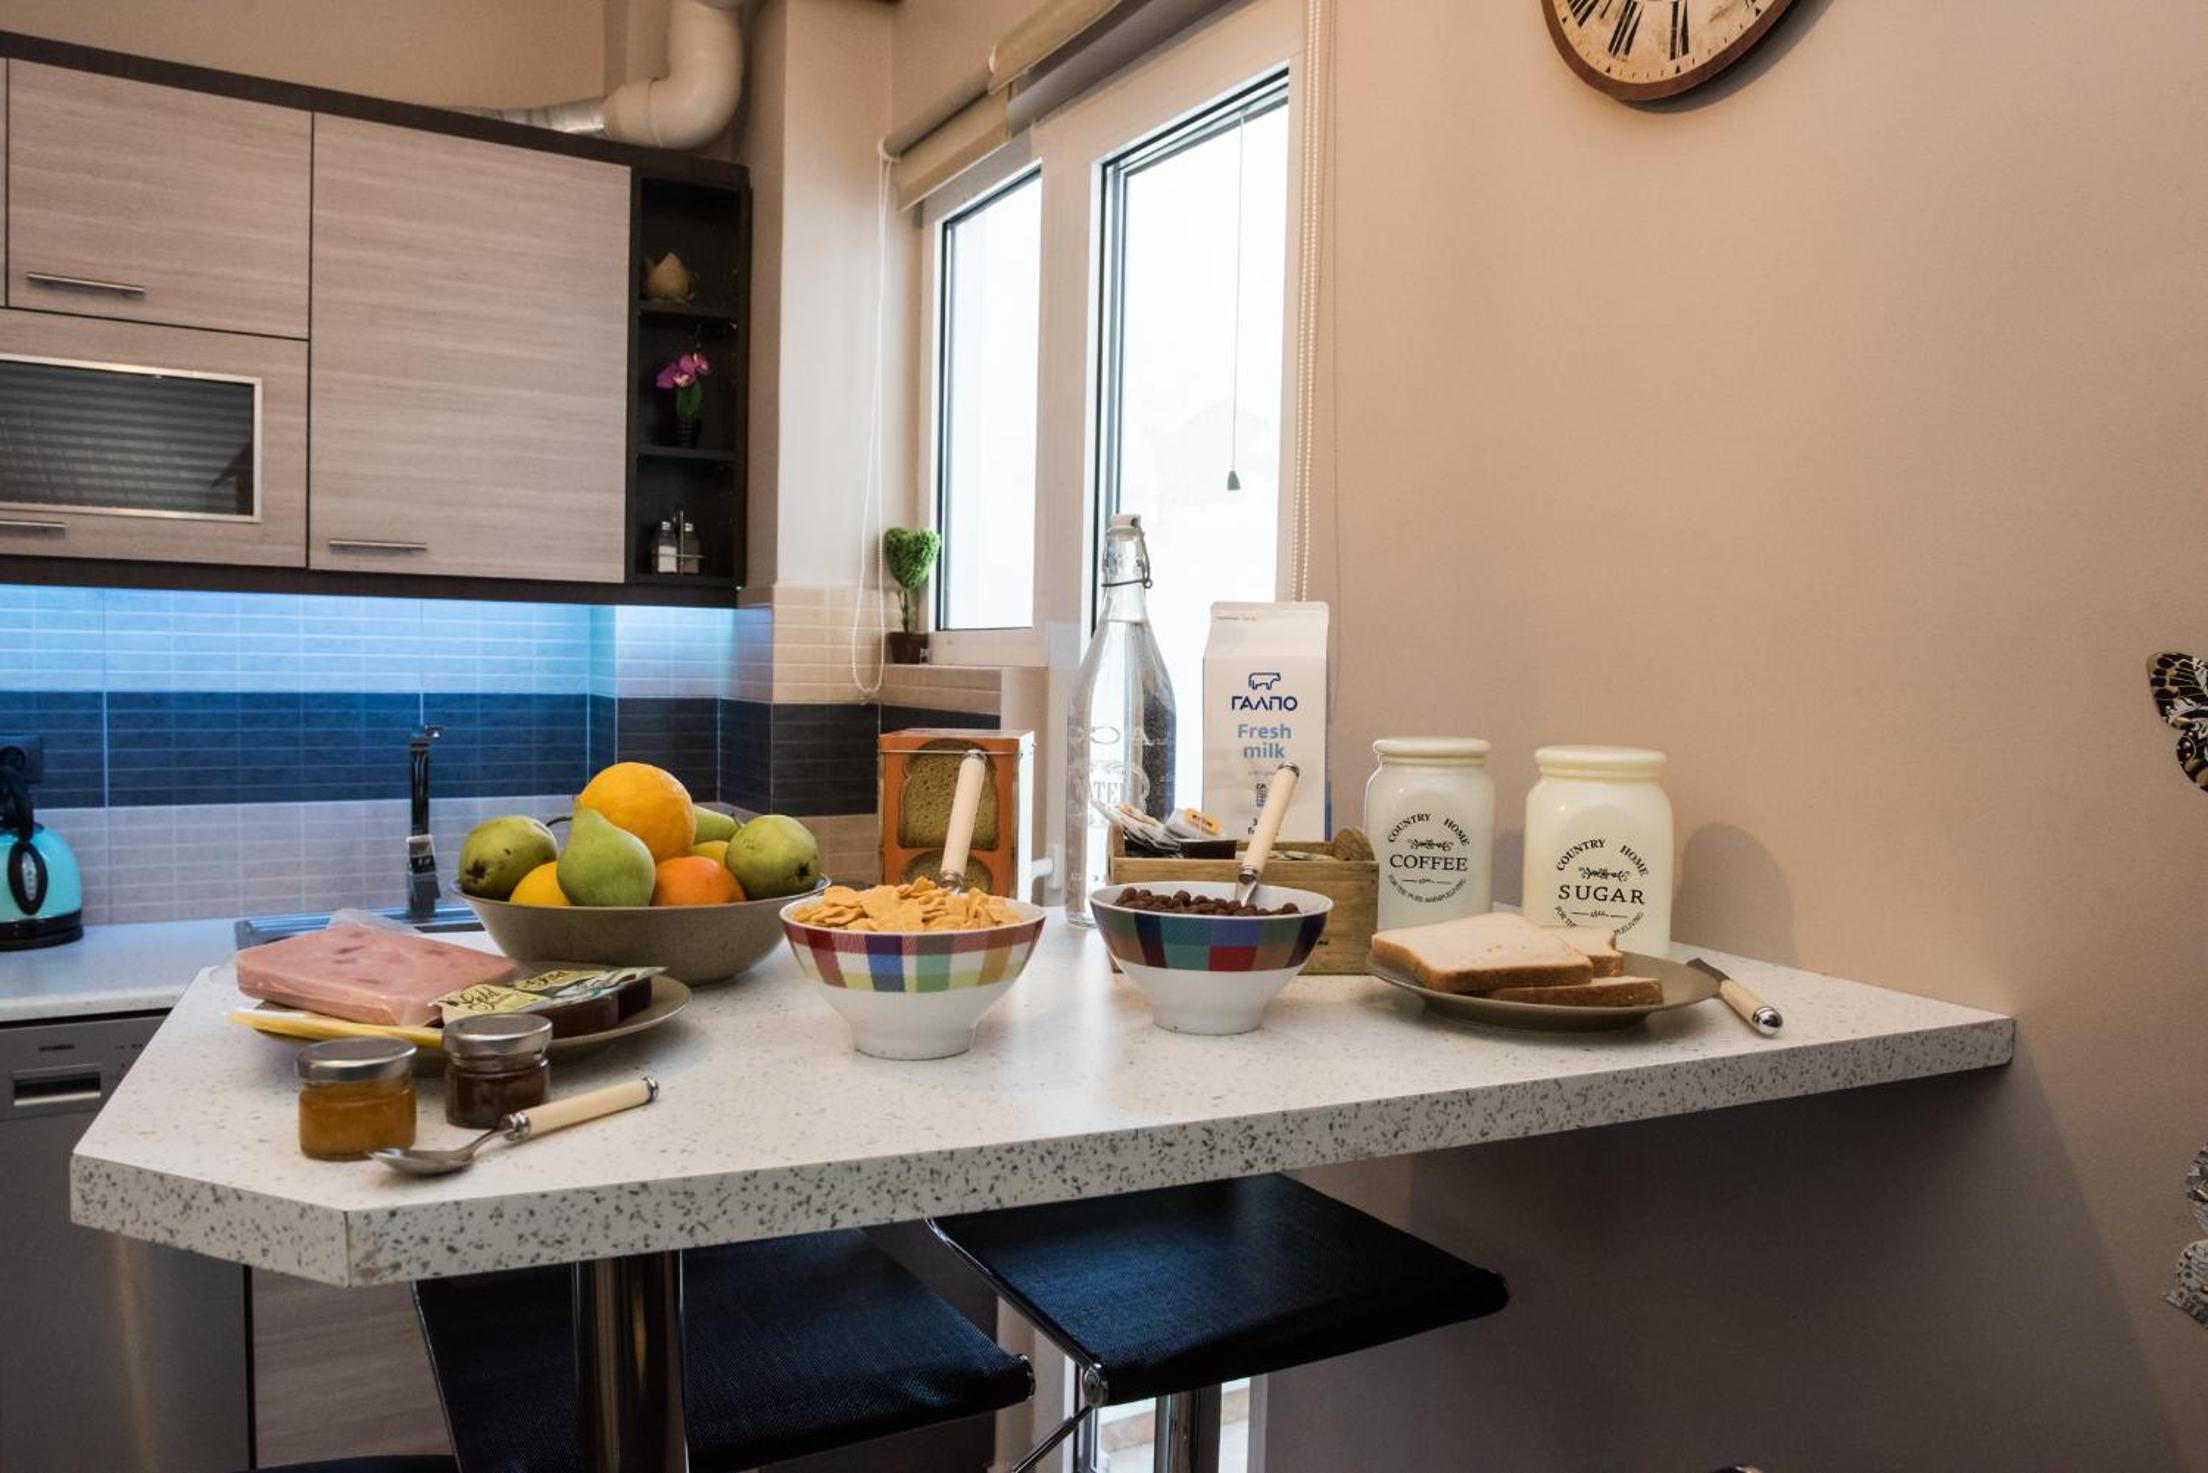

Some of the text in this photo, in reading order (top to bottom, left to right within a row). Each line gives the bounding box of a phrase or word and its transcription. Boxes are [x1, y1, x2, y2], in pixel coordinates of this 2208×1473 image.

[1231, 695, 1298, 712] ΓΑΛΠΟ
[1237, 723, 1292, 739] Fresh
[1243, 742, 1286, 759] milk
[1387, 813, 1470, 846] COUNTRY HOME
[1389, 853, 1469, 872] COFFEE
[1556, 838, 1650, 877] COUNTRY HOME
[1558, 883, 1646, 905] SUGAR
